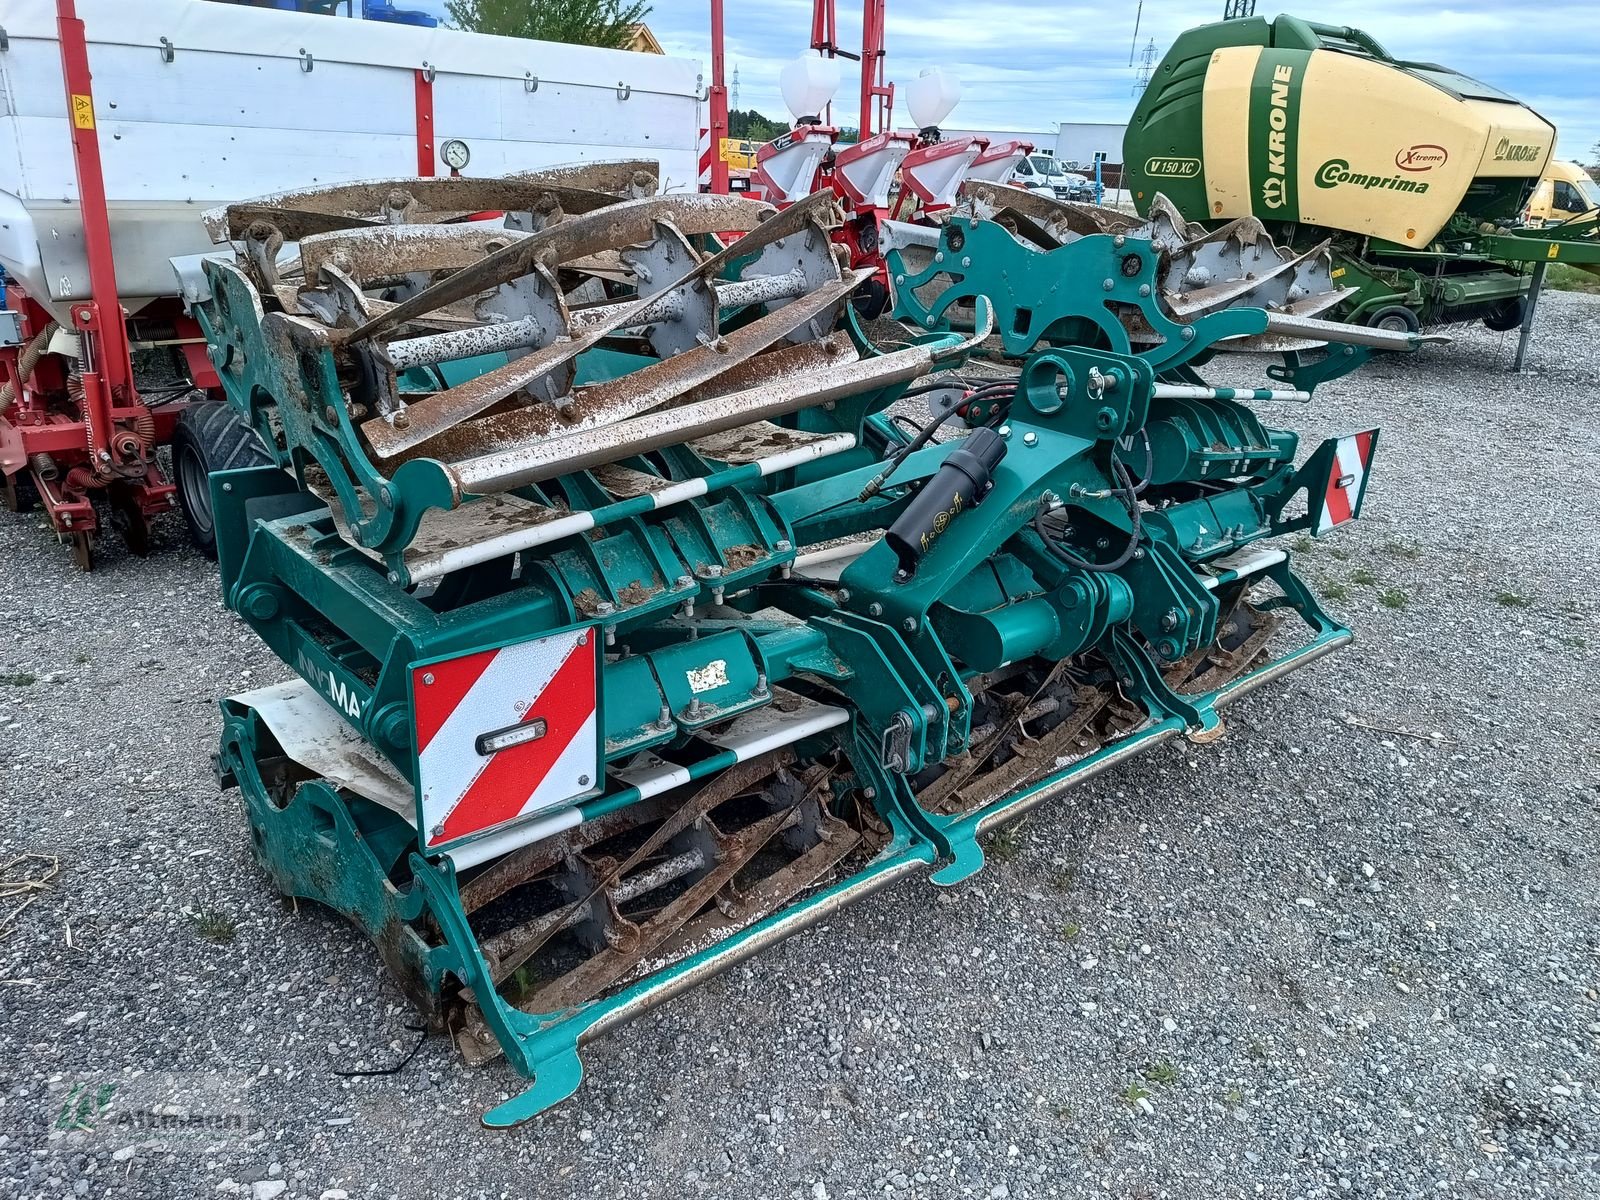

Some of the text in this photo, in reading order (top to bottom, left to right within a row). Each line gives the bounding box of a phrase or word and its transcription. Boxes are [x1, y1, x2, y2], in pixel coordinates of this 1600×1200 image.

[1268, 64, 1293, 175] KRONE
[1151, 161, 1194, 174] V 150 XC
[1400, 151, 1442, 164] X-treme
[1313, 158, 1430, 194] Comprima
